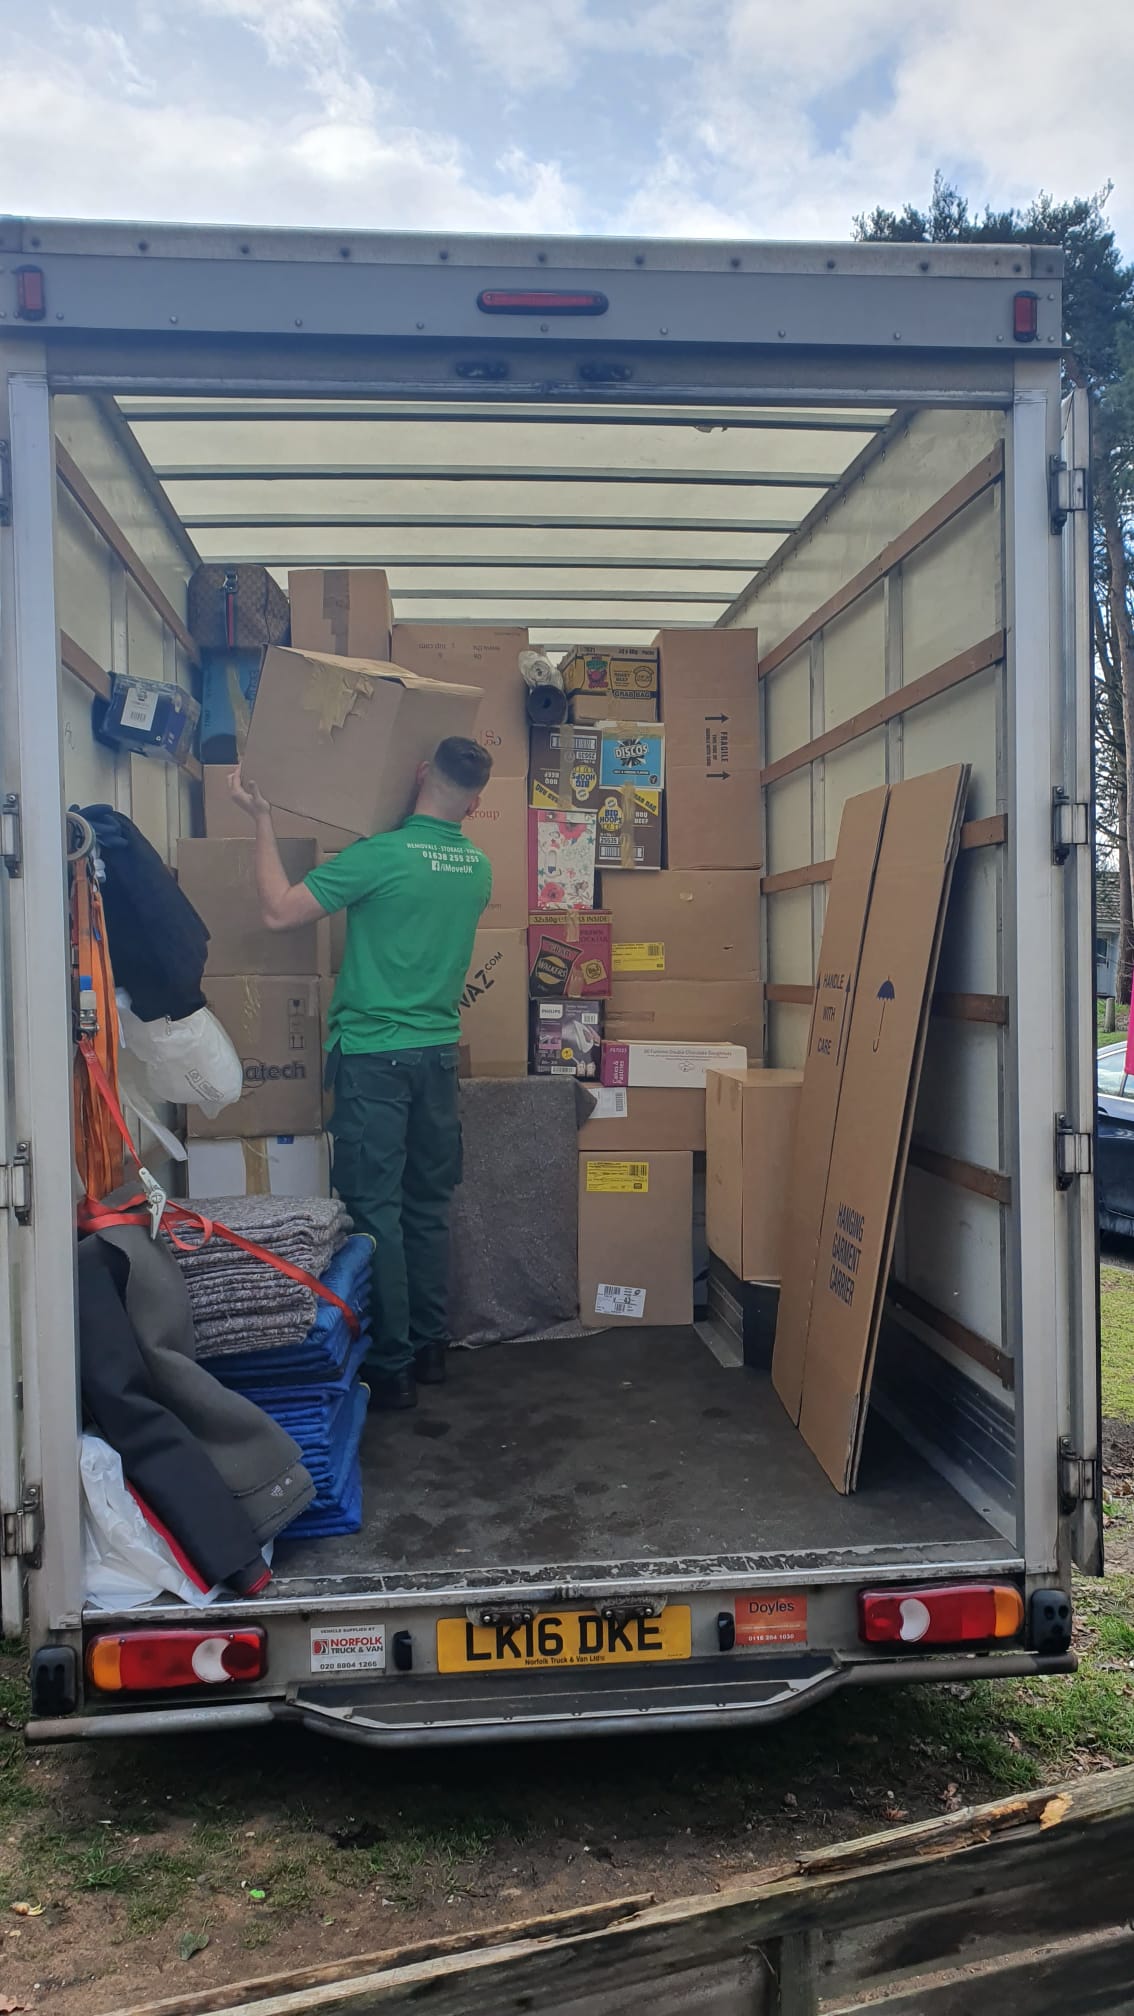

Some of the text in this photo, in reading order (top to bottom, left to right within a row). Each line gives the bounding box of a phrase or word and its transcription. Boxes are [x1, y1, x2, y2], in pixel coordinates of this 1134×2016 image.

[615, 743, 649, 759] DISCOS
[720, 731, 729, 763] FRAGILE
[571, 772, 596, 781] HOOPS
[576, 779, 590, 788] BIG
[600, 816, 622, 824] HOOPS
[604, 809, 619, 817] BIG
[422, 850, 480, 863] 01638 255 255
[440, 845, 464, 854] STORAGE
[537, 959, 568, 978] WALKERS
[822, 972, 845, 990] HANDLE
[822, 1005, 836, 1021] WITH
[817, 1037, 832, 1056] CARE
[837, 1201, 864, 1242] HANGING
[832, 1231, 862, 1275] GARMENT
[829, 1263, 855, 1307] CARRIER
[749, 1600, 794, 1616] Doyles
[330, 1636, 383, 1648] NORFOLK
[578, 1614, 663, 1655] DKE
[331, 1646, 357, 1654] TRUCK
[366, 1645, 384, 1653] VAN
[551, 1656, 568, 1664] Truck
